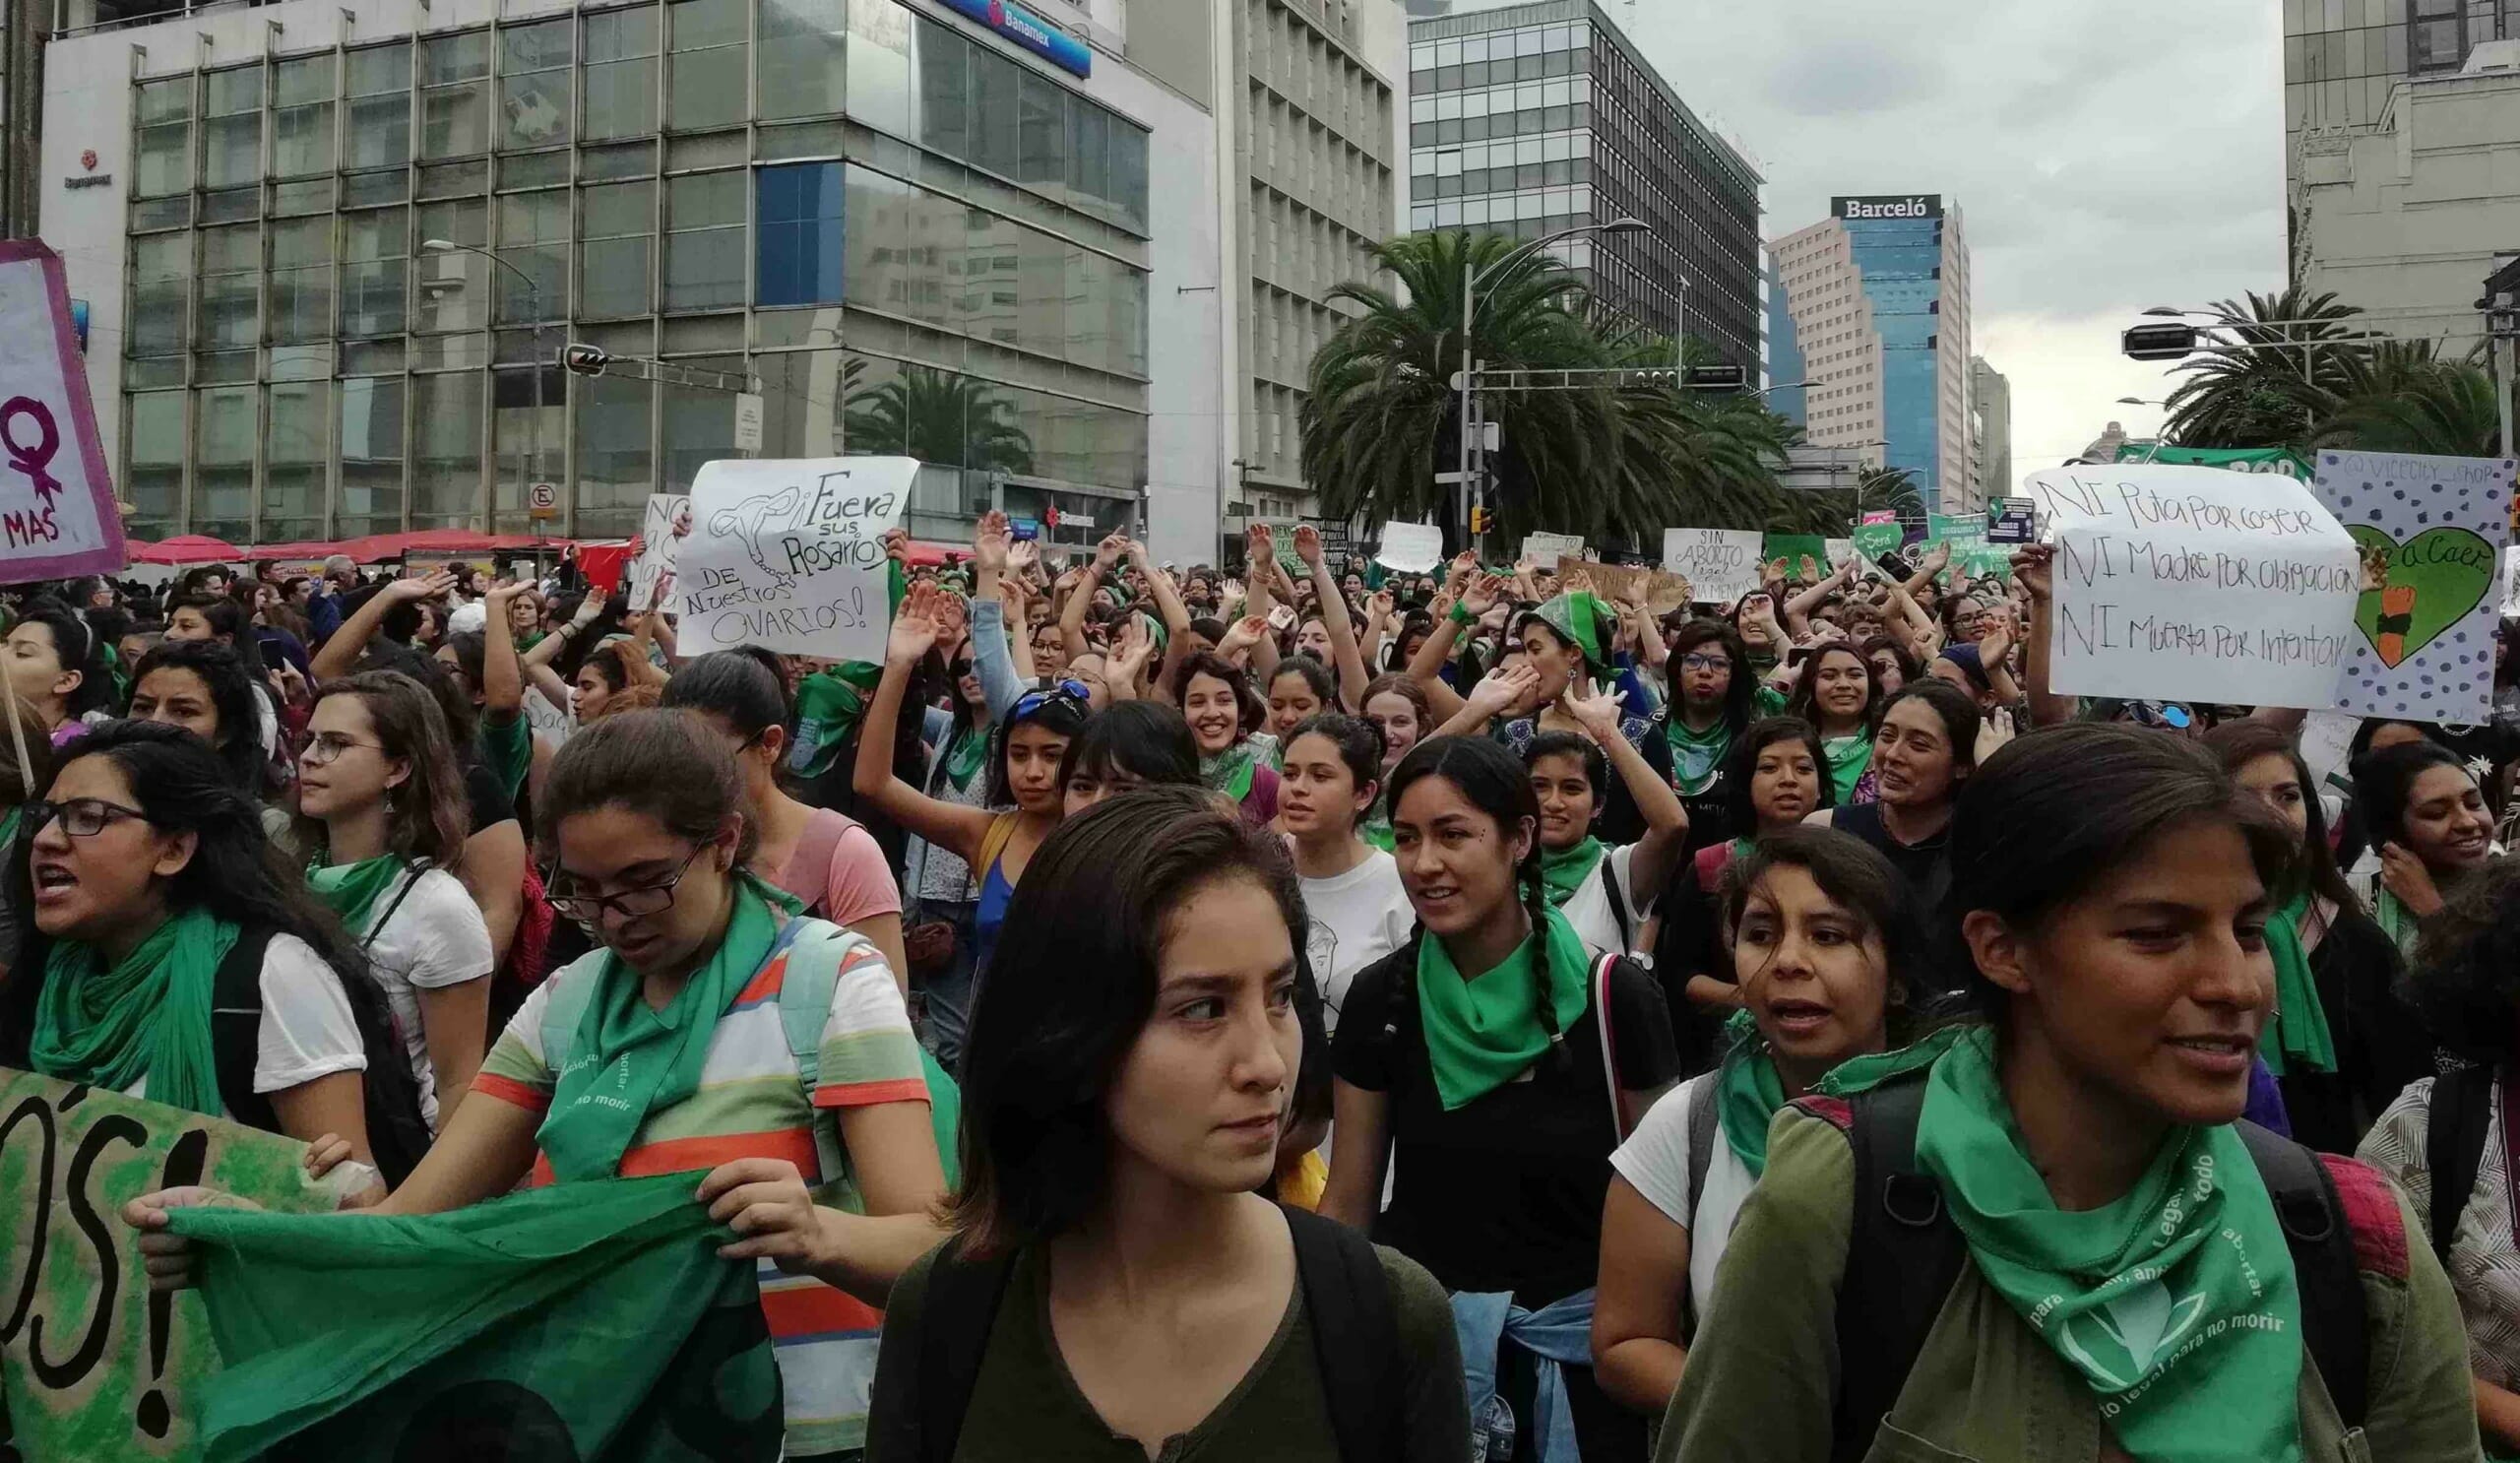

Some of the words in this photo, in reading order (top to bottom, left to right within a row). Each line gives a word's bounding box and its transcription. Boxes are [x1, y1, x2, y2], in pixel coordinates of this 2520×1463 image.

[1004, 9, 1049, 48] Banamex
[1845, 197, 1927, 218] Barceló
[537, 488, 550, 503] E
[2037, 476, 2113, 518] NI
[2116, 481, 2189, 529] Puta
[3, 507, 59, 548] MAS
[819, 522, 859, 537] sus
[1700, 530, 1725, 544] SIN
[1675, 544, 1743, 567] ABORTO
[2061, 536, 2117, 588] NI
[700, 567, 740, 591] DE
[686, 580, 792, 616] Nuestros
[711, 586, 867, 644] OVARIOS!
[2061, 603, 2118, 657] NI
[594, 1095, 632, 1112] morir
[2192, 1155, 2214, 1203] todo
[2222, 1228, 2263, 1299] abortar
[2029, 1292, 2065, 1328] para
[2170, 1333, 2205, 1368] para
[2206, 1317, 2227, 1339] no
[2231, 1311, 2285, 1332] morir
